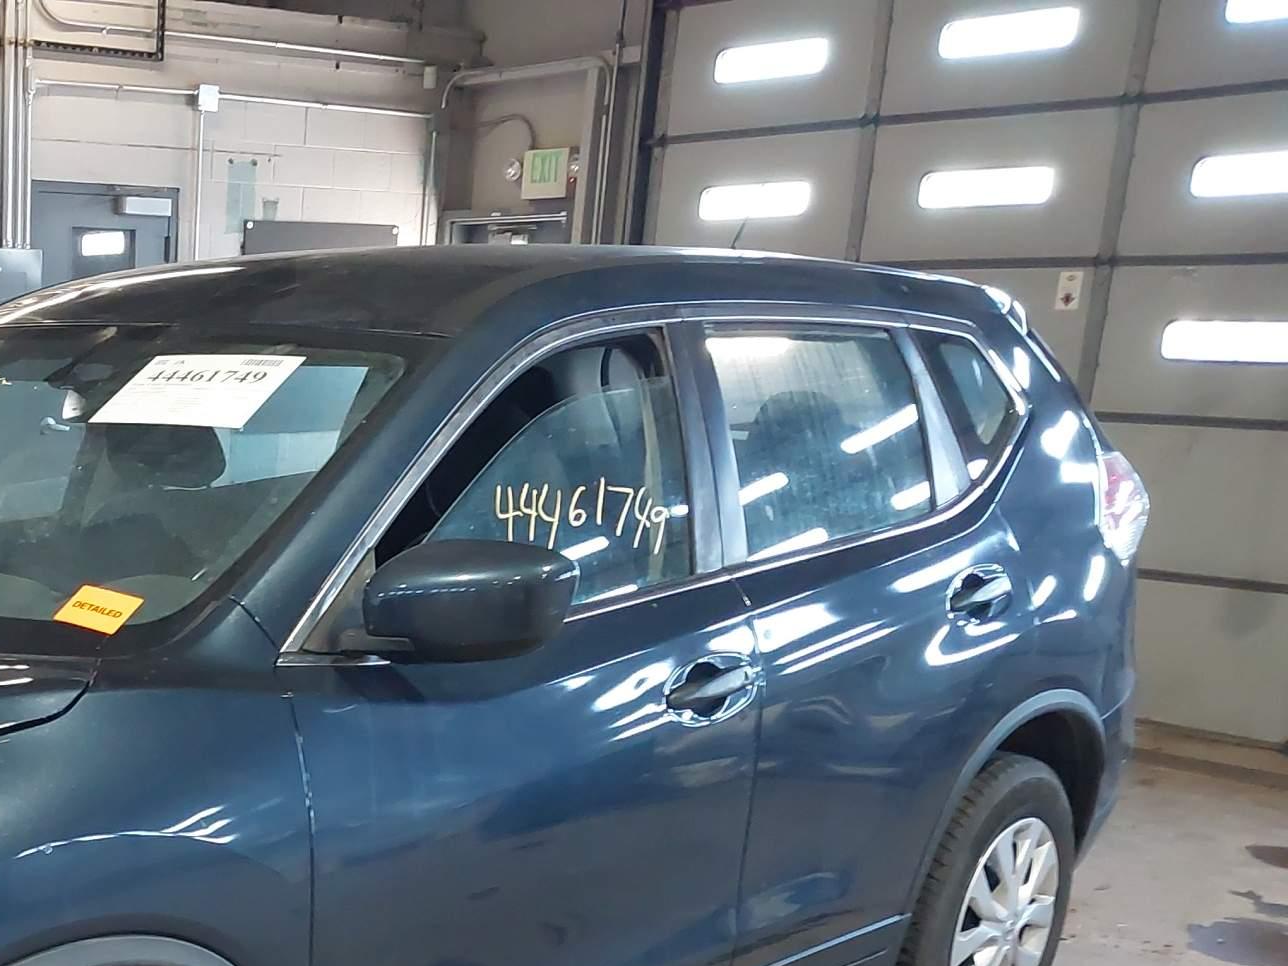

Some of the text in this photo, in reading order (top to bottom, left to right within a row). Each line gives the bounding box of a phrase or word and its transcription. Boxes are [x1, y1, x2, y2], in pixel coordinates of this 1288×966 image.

[147, 369, 268, 384] 44461749
[496, 476, 672, 555] 44461749
[72, 600, 123, 619] DETAILED
